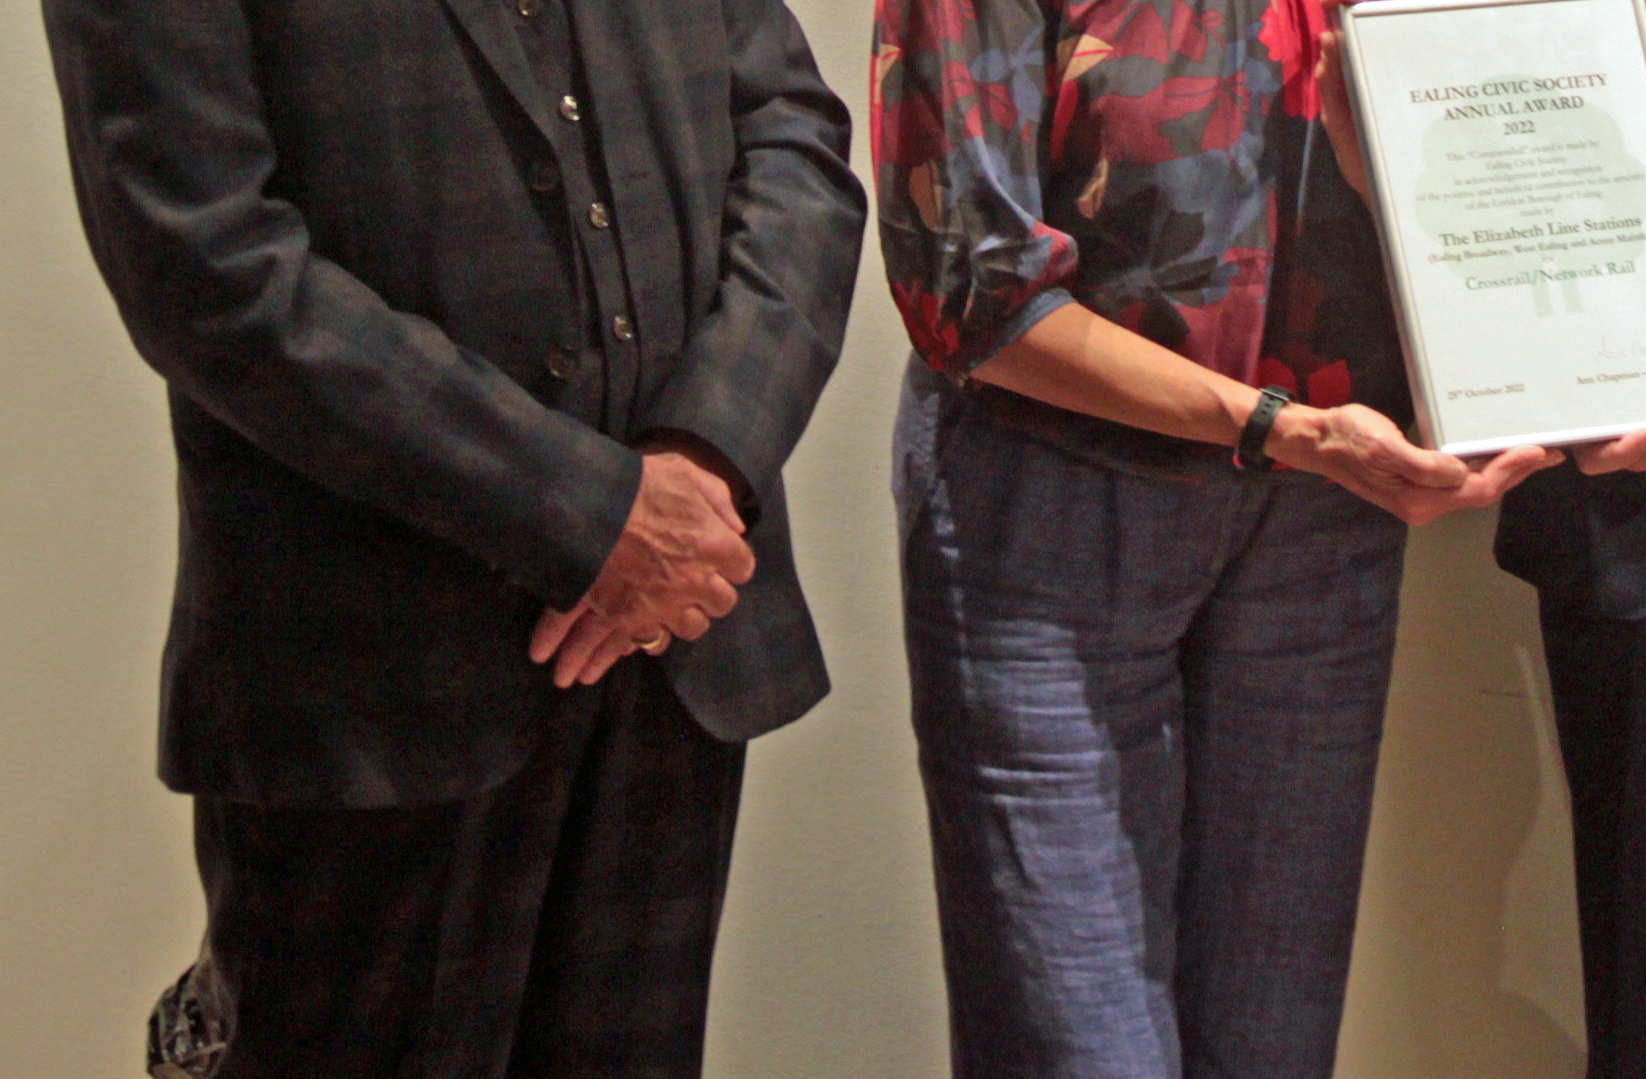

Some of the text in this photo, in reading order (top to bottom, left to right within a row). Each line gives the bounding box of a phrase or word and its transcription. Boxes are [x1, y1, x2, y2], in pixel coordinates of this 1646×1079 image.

[1410, 72, 1608, 103] EALING CIVIC SOCIETY
[1443, 95, 1585, 121] ANNUAL AWARD
[1503, 119, 1536, 136] 2022
[1438, 215, 1642, 247] The Elizabeth Line Stations
[1606, 259, 1637, 275] Rail
